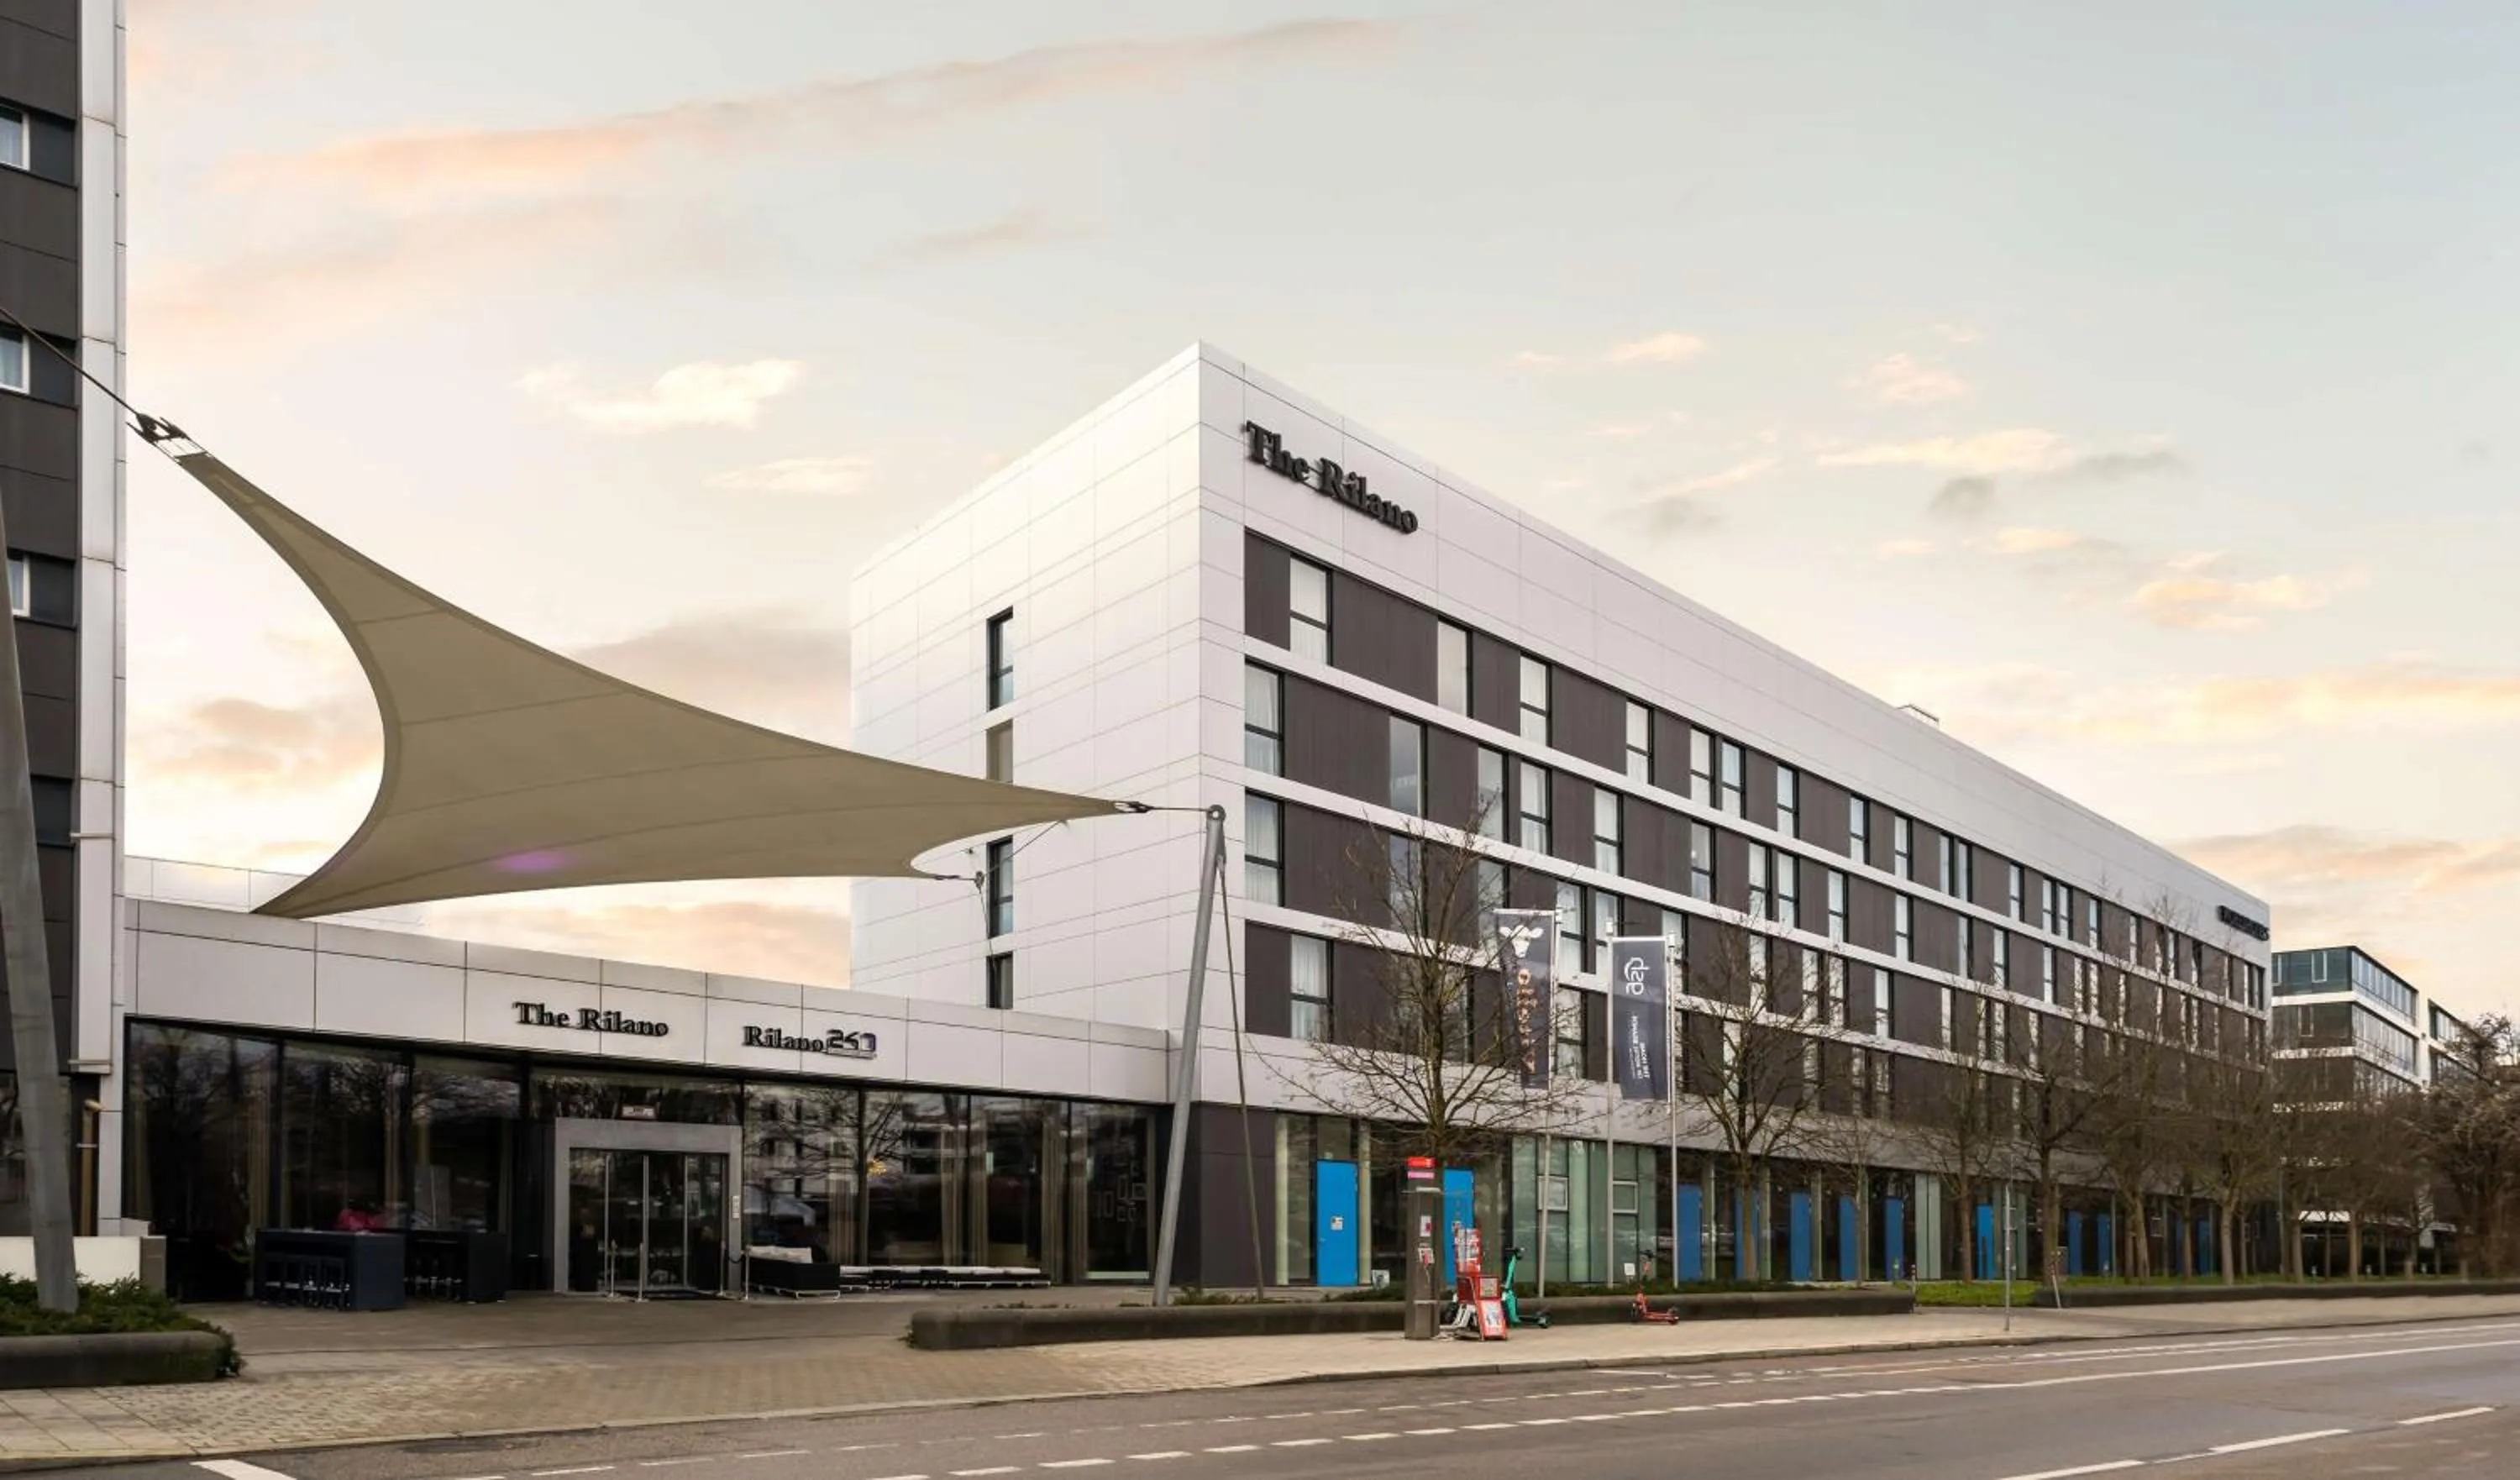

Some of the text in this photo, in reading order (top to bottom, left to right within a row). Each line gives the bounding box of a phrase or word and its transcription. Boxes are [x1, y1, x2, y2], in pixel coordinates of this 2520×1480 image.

[1241, 420, 1419, 534] The Rilano
[512, 1002, 669, 1037] The Rilano
[742, 1026, 824, 1052] Rilano
